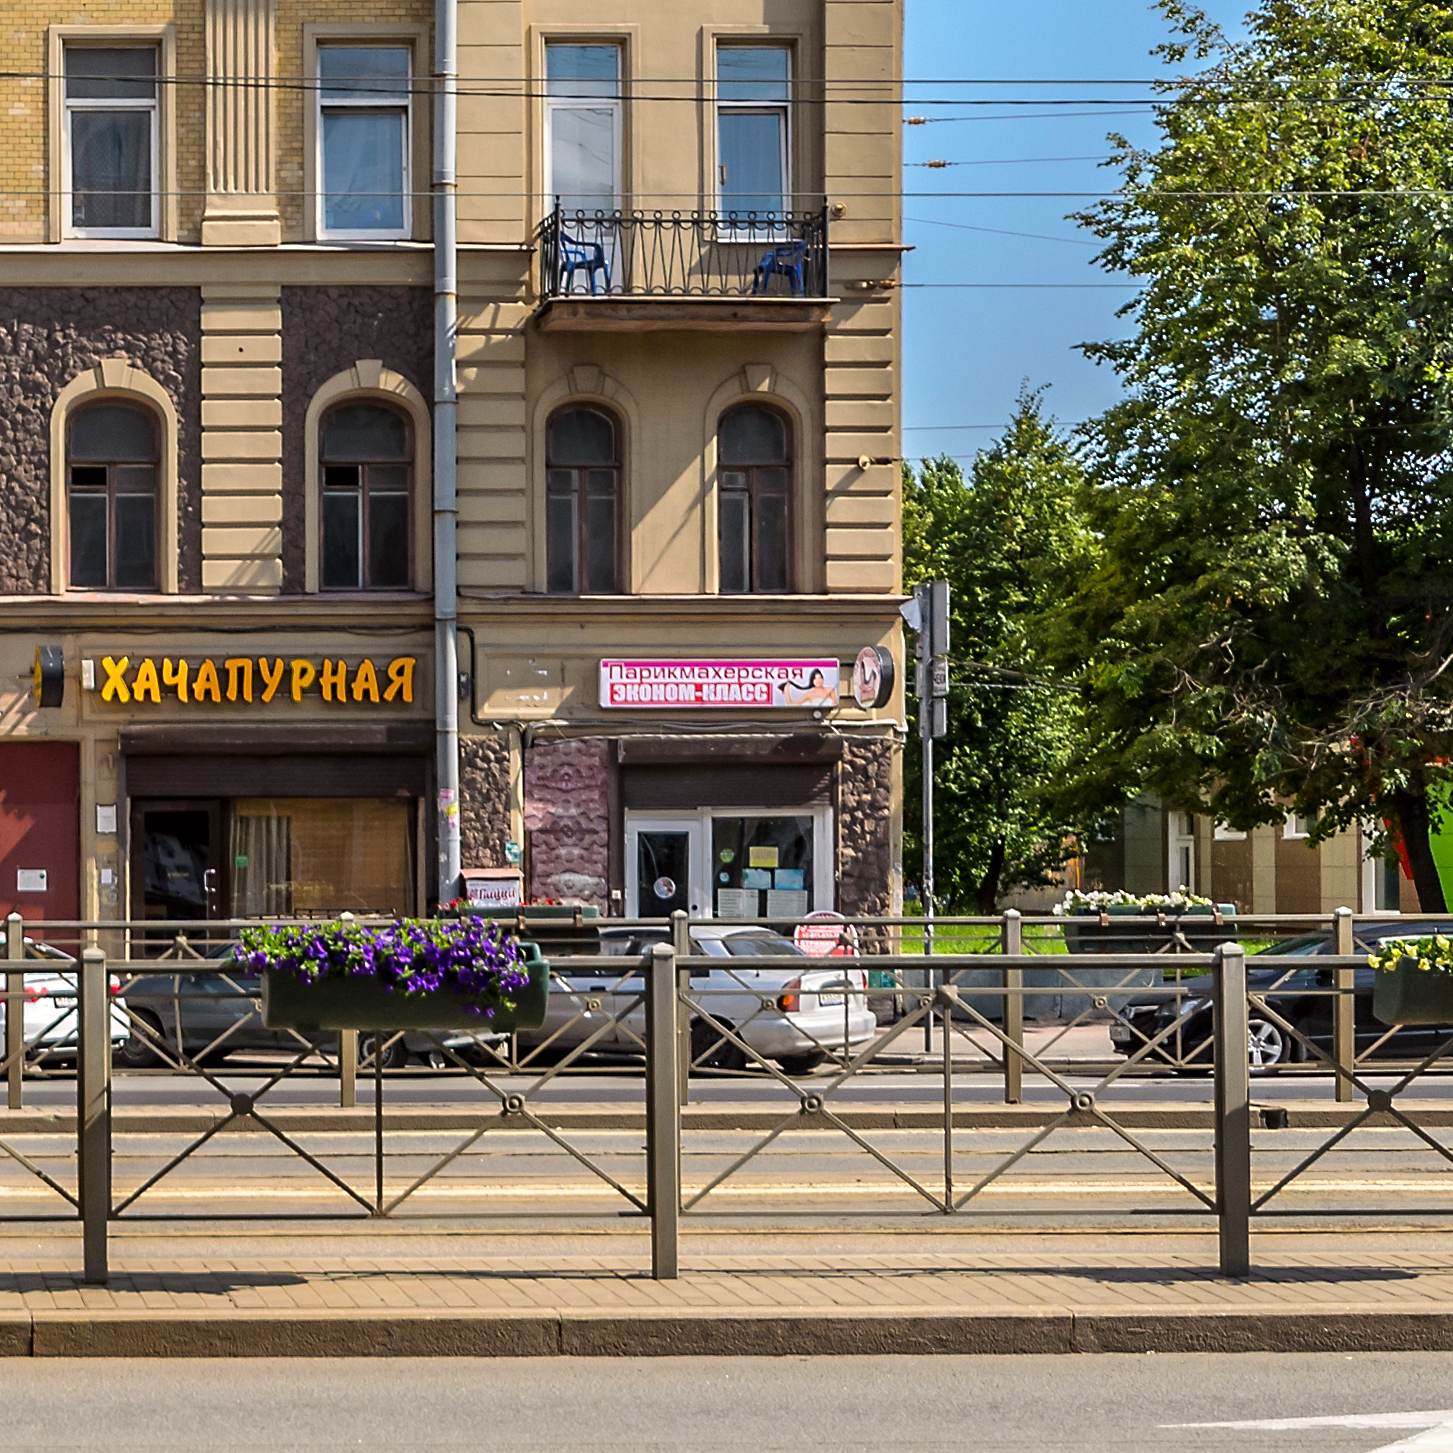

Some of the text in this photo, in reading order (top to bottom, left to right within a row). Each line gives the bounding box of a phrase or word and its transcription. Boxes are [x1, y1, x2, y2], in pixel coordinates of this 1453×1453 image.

[101, 656, 416, 704] ХАЧАПУРНАЯ
[608, 663, 804, 683] Парикмахерская
[613, 683, 768, 702] ЭКОНОМ-КЛАСС
